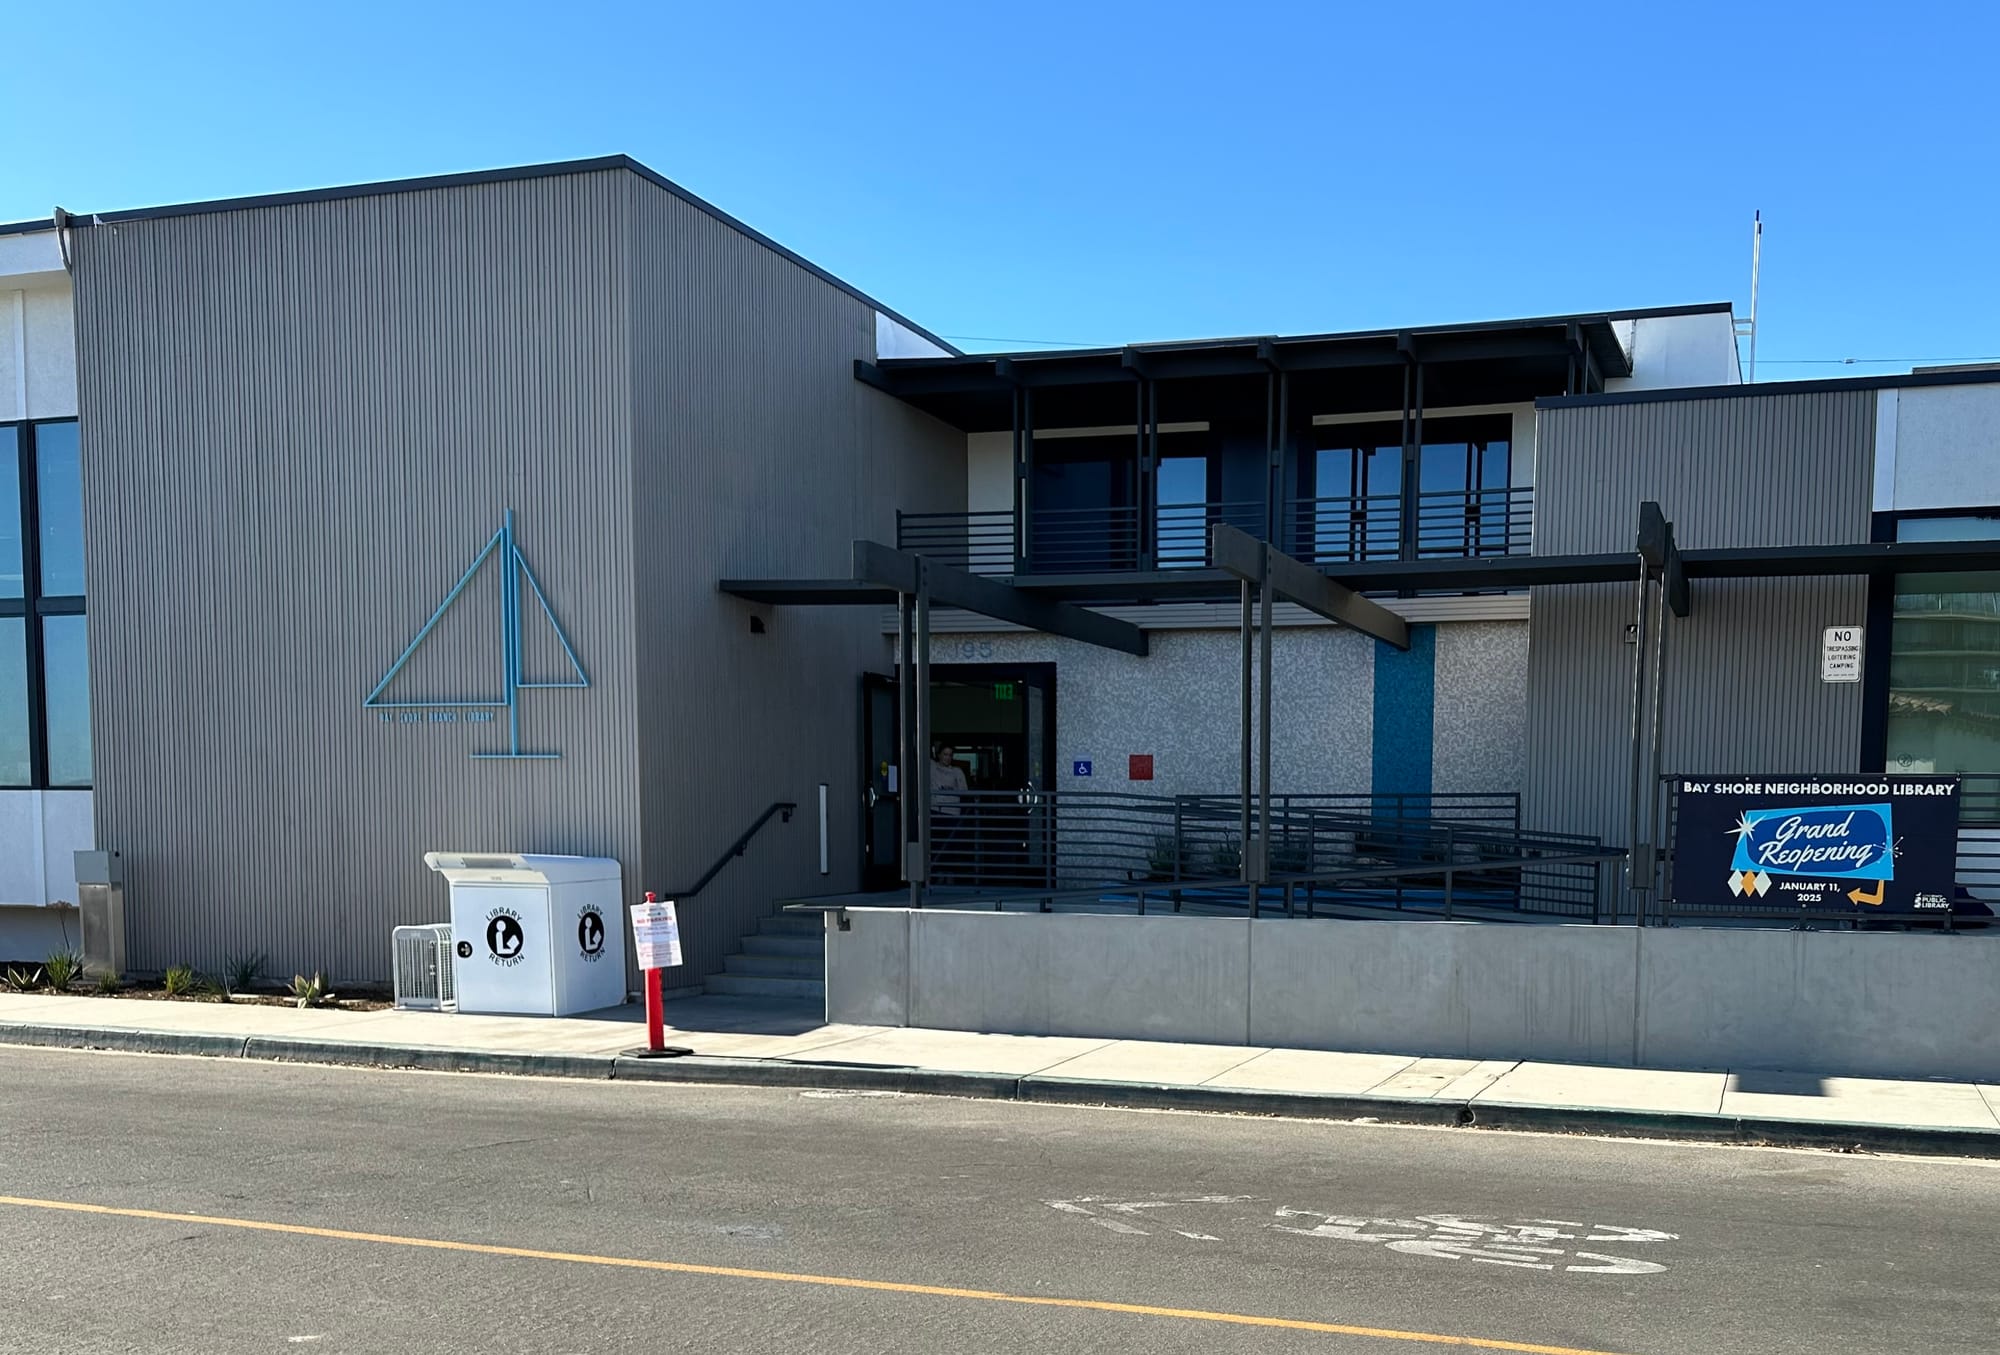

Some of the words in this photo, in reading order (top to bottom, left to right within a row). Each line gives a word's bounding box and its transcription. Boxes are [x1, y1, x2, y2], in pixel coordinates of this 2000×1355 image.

[1834, 631, 1852, 641] NO
[463, 711, 495, 722] LIBRARY
[1683, 781, 1710, 794] BAY
[1714, 783, 1761, 795] SHORE
[1764, 783, 1889, 796] NEIGHBORHOOD
[1893, 783, 1954, 796] LIBRARY
[1775, 811, 1855, 842] Grand
[1759, 840, 1873, 872] Reopening
[1779, 882, 1826, 891] JANUARY
[1828, 882, 1841, 893] 11,
[1797, 893, 1822, 902] 2025
[485, 906, 523, 922] LIBRARY
[577, 903, 604, 919] LIBRARY
[488, 953, 525, 968] RETURN
[579, 946, 606, 963] RETURN
